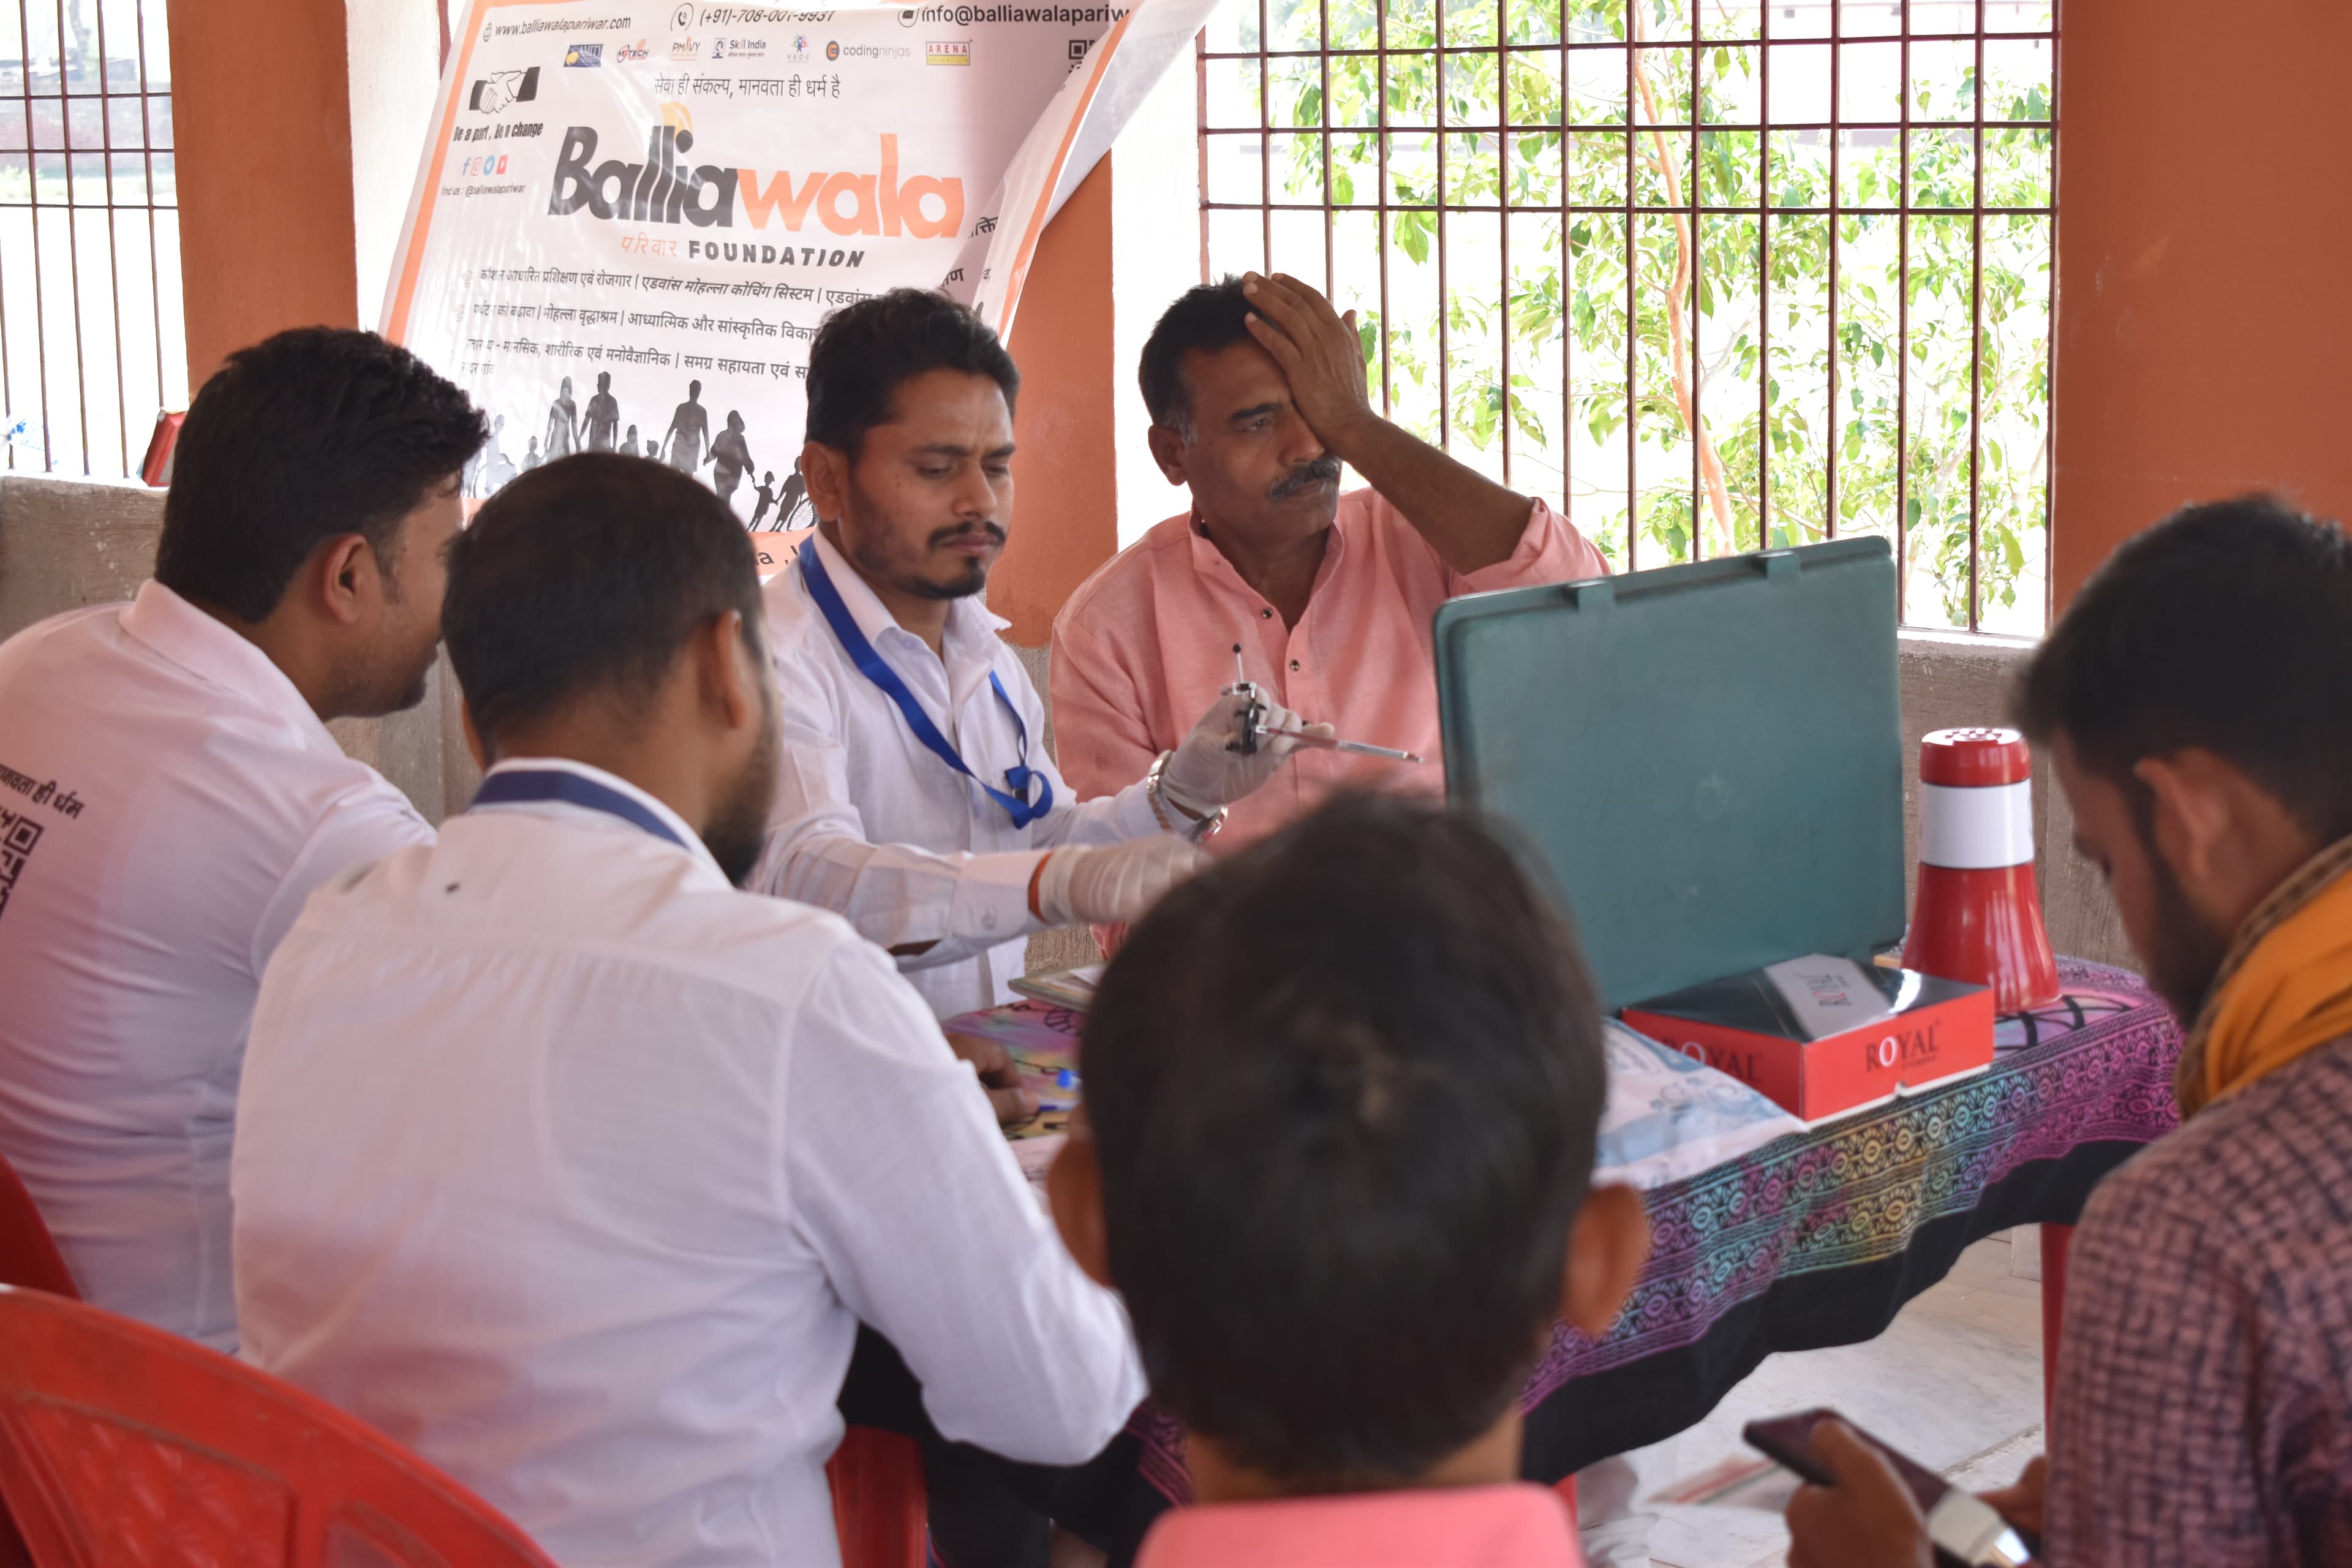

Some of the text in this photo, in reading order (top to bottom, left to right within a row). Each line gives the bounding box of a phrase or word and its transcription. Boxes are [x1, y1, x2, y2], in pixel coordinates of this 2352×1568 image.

[494, 17, 631, 36] www.balliawalapariwar.com
[729, 39, 766, 49] Skill India
[843, 45, 911, 59] codingninjas
[928, 44, 968, 54] ARENA
[654, 72, 676, 95] सेवा
[677, 73, 690, 95] ही
[739, 79, 785, 96] मानवता
[788, 74, 802, 97] ही
[806, 75, 828, 97] धर्म
[831, 74, 841, 98] है
[453, 126, 464, 141] Be
[464, 127, 472, 141] a
[511, 122, 544, 138] change
[620, 232, 677, 258] परिवार
[688, 240, 865, 268] FOUNDATION
[507, 266, 542, 283] आधारित
[542, 267, 578, 285] प्रशिक्षण
[580, 270, 595, 288] एवं
[597, 269, 633, 288] रोजगार
[642, 276, 684, 292] एडवांस
[684, 277, 731, 295] मोहल्ला
[730, 281, 772, 298] कोचिंग
[773, 283, 815, 301] सिस्टम
[543, 303, 577, 322] मोहल्ला
[579, 309, 619, 326] वृद्धाश्रम
[627, 311, 689, 330] आध्यात्मिक
[692, 314, 715, 332] और
[717, 317, 778, 340] सांस्कृतिक
[545, 341, 584, 359] शारीरिक
[587, 344, 603, 363] एवं
[606, 345, 671, 366] मनोवैज्ञानिक
[684, 355, 714, 371] समग्र
[717, 357, 766, 375] सहायता
[770, 361, 791, 380] एवं
[32, 780, 58, 805] ही
[53, 790, 86, 820] धर्म
[1865, 1025, 1940, 1072] ROYAL
